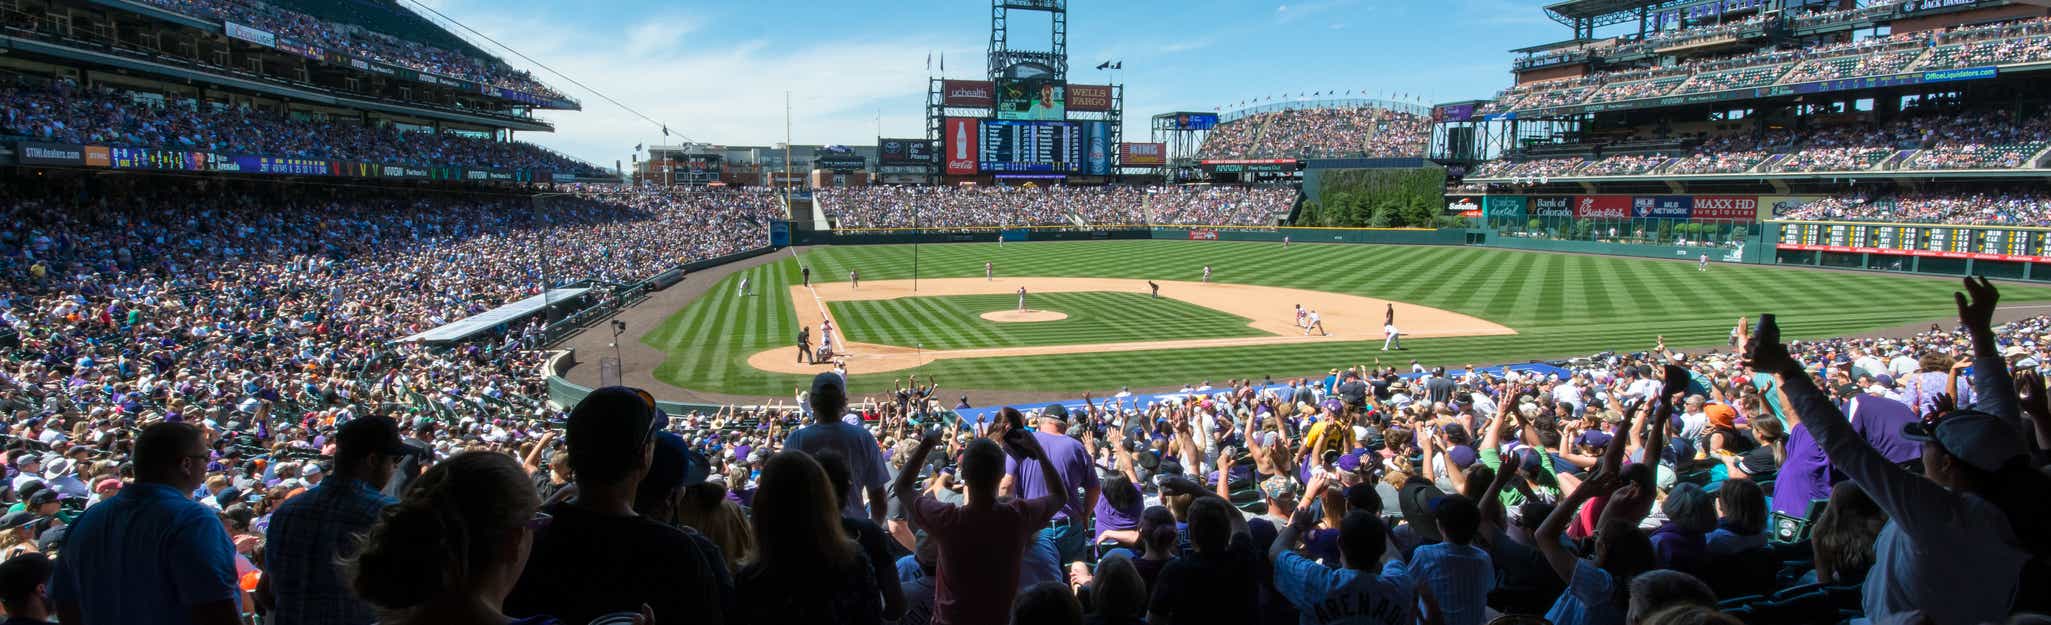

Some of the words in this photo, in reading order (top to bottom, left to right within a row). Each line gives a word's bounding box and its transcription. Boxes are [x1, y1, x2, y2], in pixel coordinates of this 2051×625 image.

[1925, 69, 1994, 81] OfficeLiquidators.com
[951, 87, 987, 97] uchealth
[1072, 88, 1106, 97] WELLS
[1072, 97, 1106, 106] FARGO
[26, 147, 80, 161] STIHLdealers.com
[1537, 198, 1557, 208] Bank
[1558, 197, 1568, 207] of
[1664, 201, 1679, 209] MLB
[1694, 199, 1733, 209] MAXX
[1736, 199, 1755, 209] HD
[1537, 207, 1573, 218] Colorado
[1653, 207, 1687, 216] NETWORK
[1694, 209, 1755, 217] sunglasses
